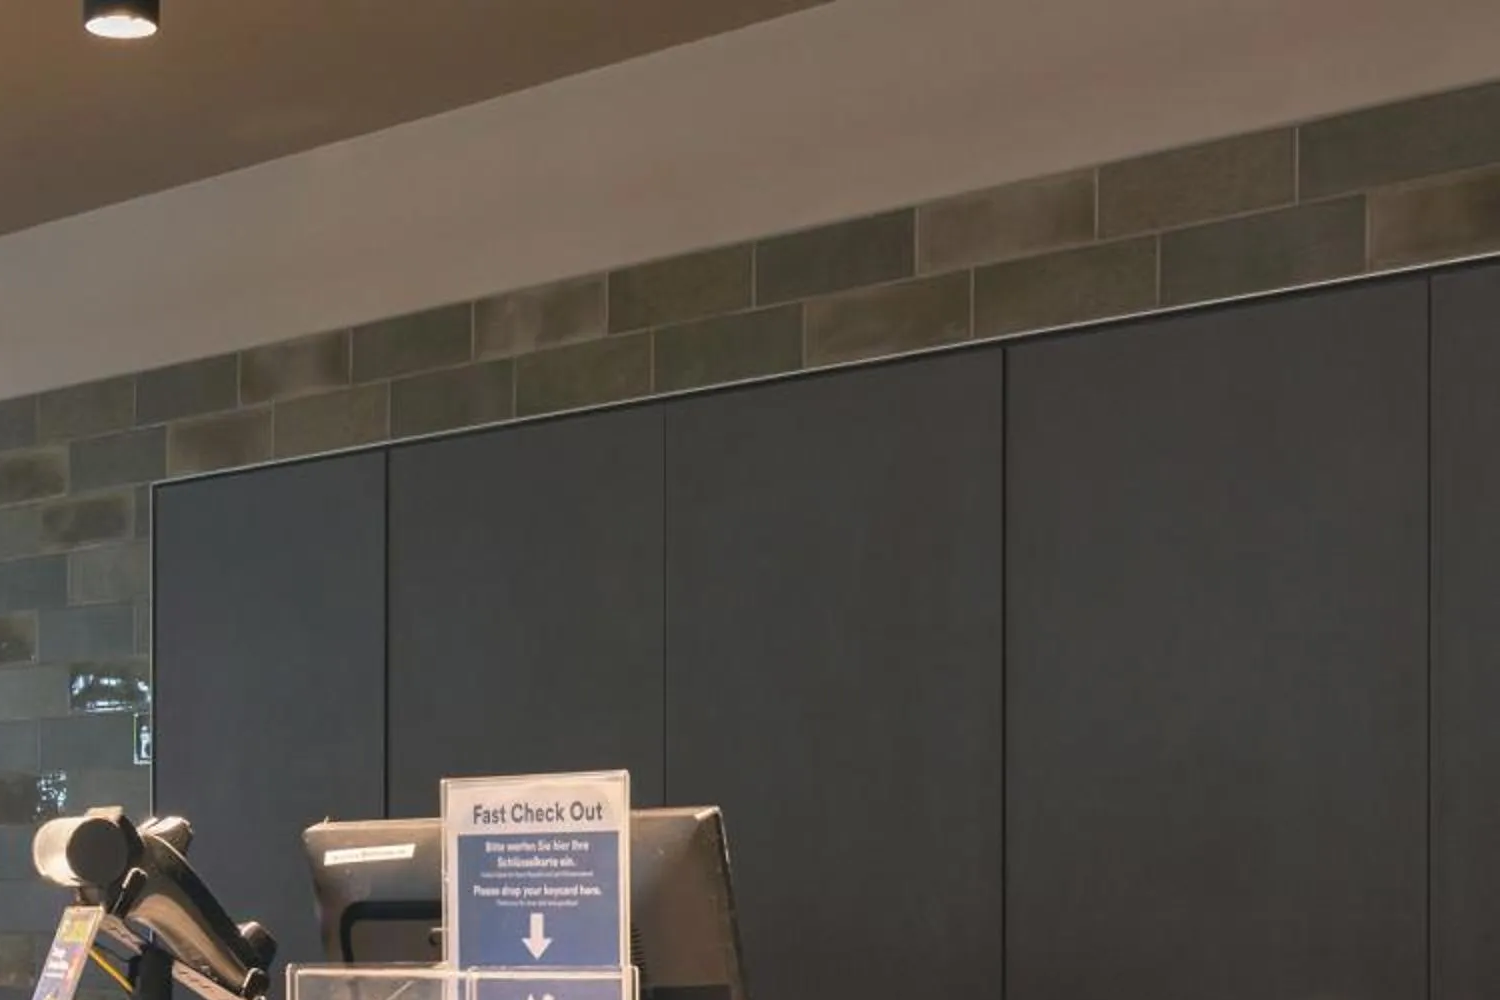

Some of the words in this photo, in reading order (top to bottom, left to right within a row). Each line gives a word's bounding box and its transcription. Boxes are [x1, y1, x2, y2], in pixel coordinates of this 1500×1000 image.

[473, 804, 506, 825] Fast
[511, 802, 565, 824] Check
[570, 801, 603, 822] Out
[538, 839, 550, 851] Sie
[553, 839, 570, 851] hier
[473, 885, 500, 897] Please
[501, 885, 521, 899] drop
[523, 886, 542, 898] your
[543, 884, 578, 898] keycard
